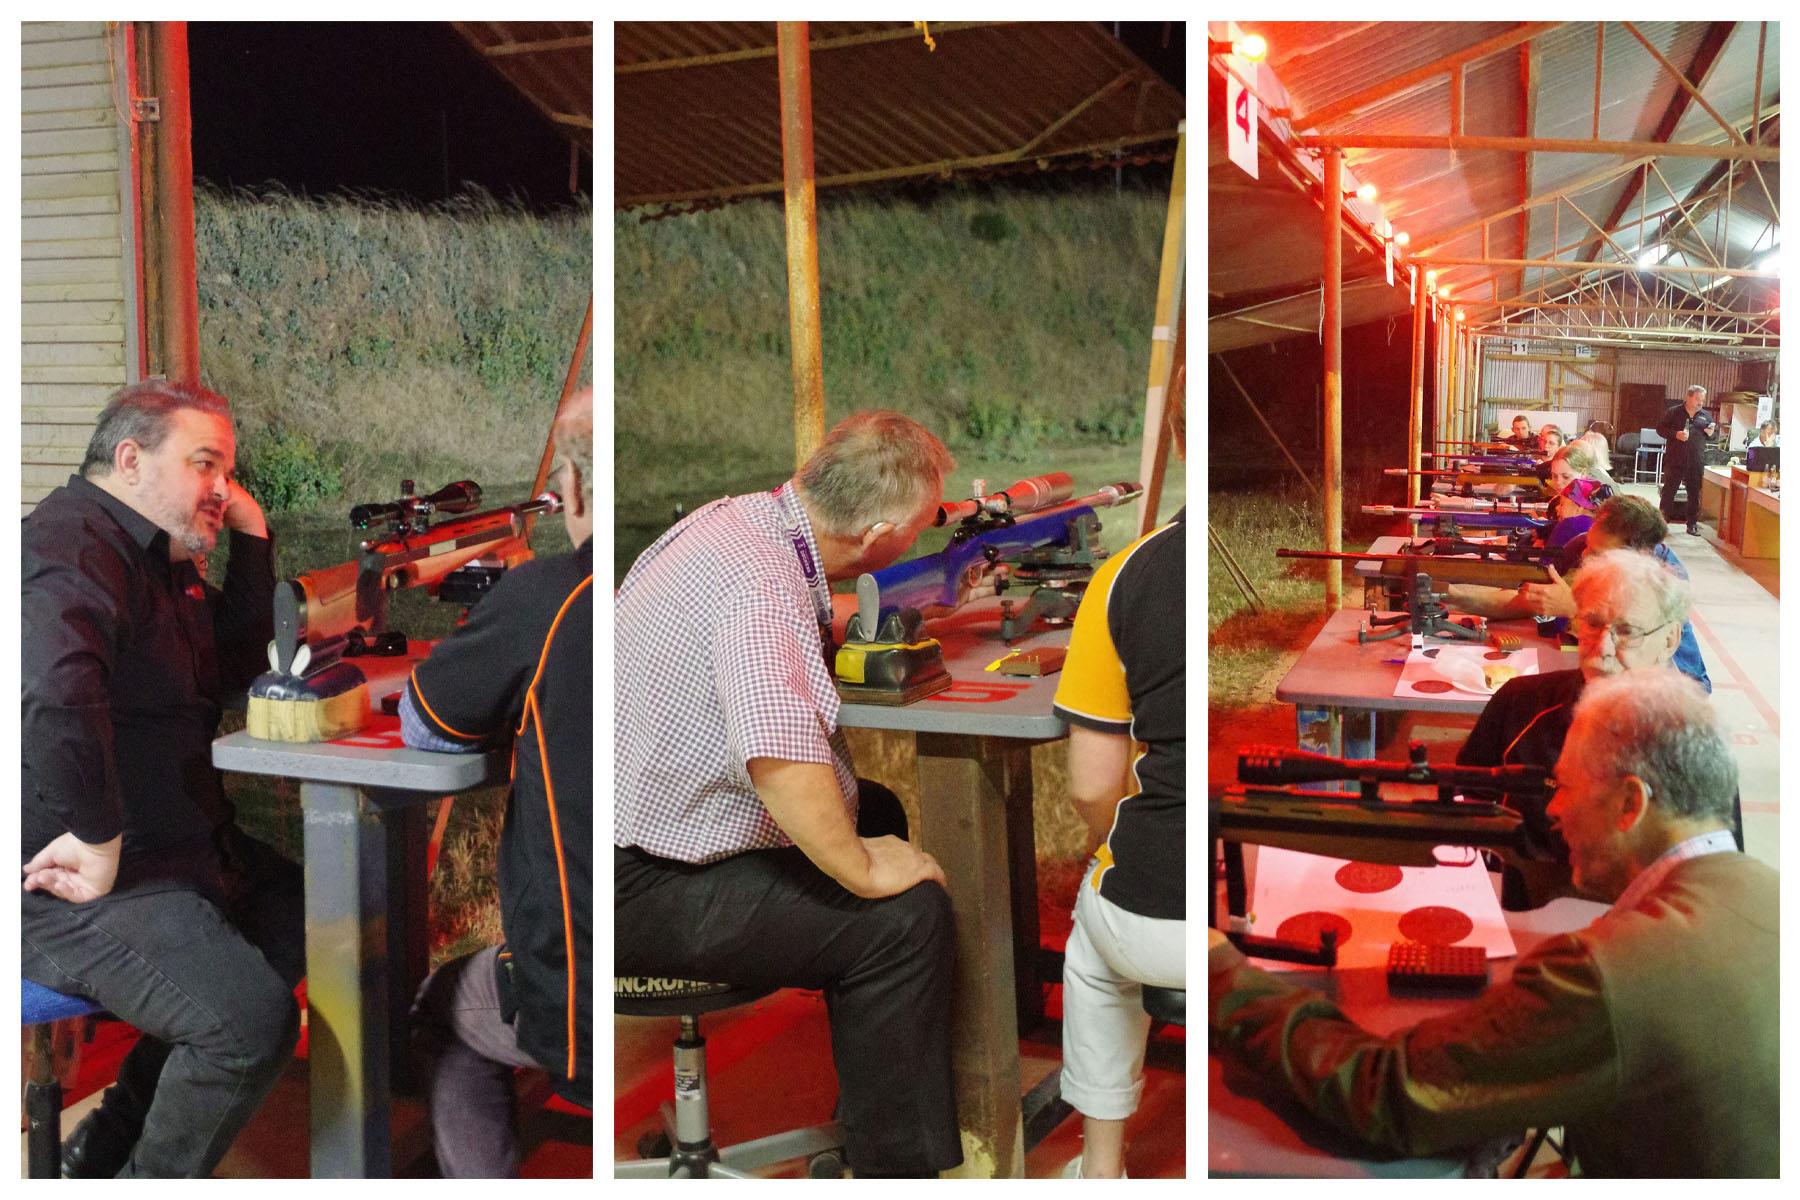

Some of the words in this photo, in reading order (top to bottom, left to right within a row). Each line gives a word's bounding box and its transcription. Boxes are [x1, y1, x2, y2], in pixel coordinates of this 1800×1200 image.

[1235, 87, 1250, 144] 4
[1513, 343, 1526, 352] 11
[1577, 345, 1590, 354] 12
